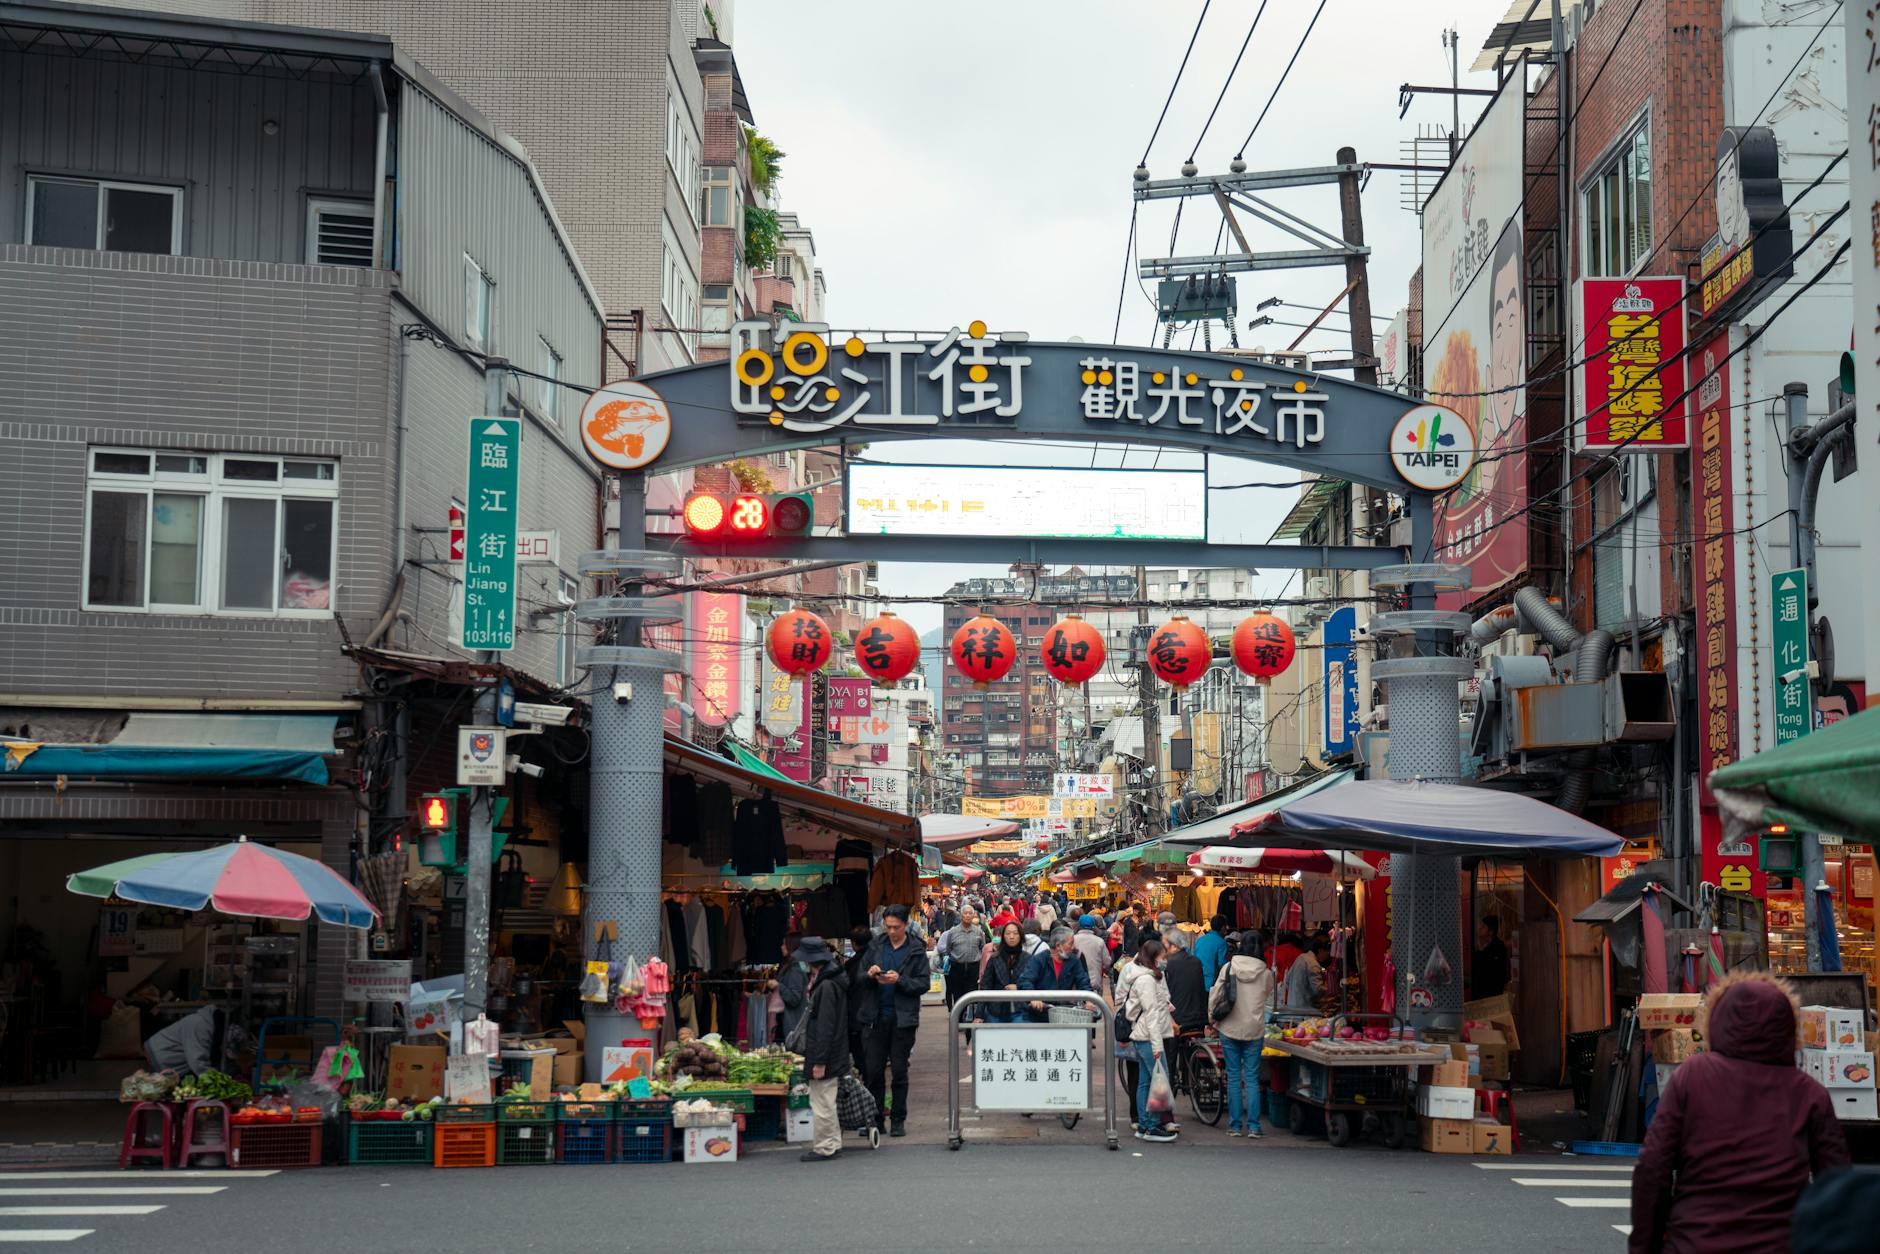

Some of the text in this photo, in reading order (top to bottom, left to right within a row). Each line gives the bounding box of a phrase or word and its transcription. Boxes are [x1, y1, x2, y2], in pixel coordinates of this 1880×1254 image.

[730, 320, 1031, 432] 臨江街
[1079, 356, 1330, 449] 觀光夜市
[1402, 453, 1459, 468] TAIPEI
[480, 442, 508, 559] 臨江街
[732, 499, 764, 530] 28
[469, 563, 490, 573] Lin
[468, 580, 507, 592] Jiang
[468, 594, 486, 605] St.
[860, 627, 894, 669] 吉
[961, 627, 1004, 670] 祥
[1048, 630, 1089, 668] 如
[1150, 632, 1190, 674] 意
[1253, 623, 1285, 667] 進寶
[1779, 596, 1802, 709] 通化街
[857, 688, 868, 696] B1
[1778, 714, 1802, 726] Tong
[1778, 730, 1798, 739] Hua
[1007, 799, 1038, 812] 50%
[981, 1048, 1082, 1062] 禁止汽機車進入
[981, 1068, 1082, 1082] 請改道通行
